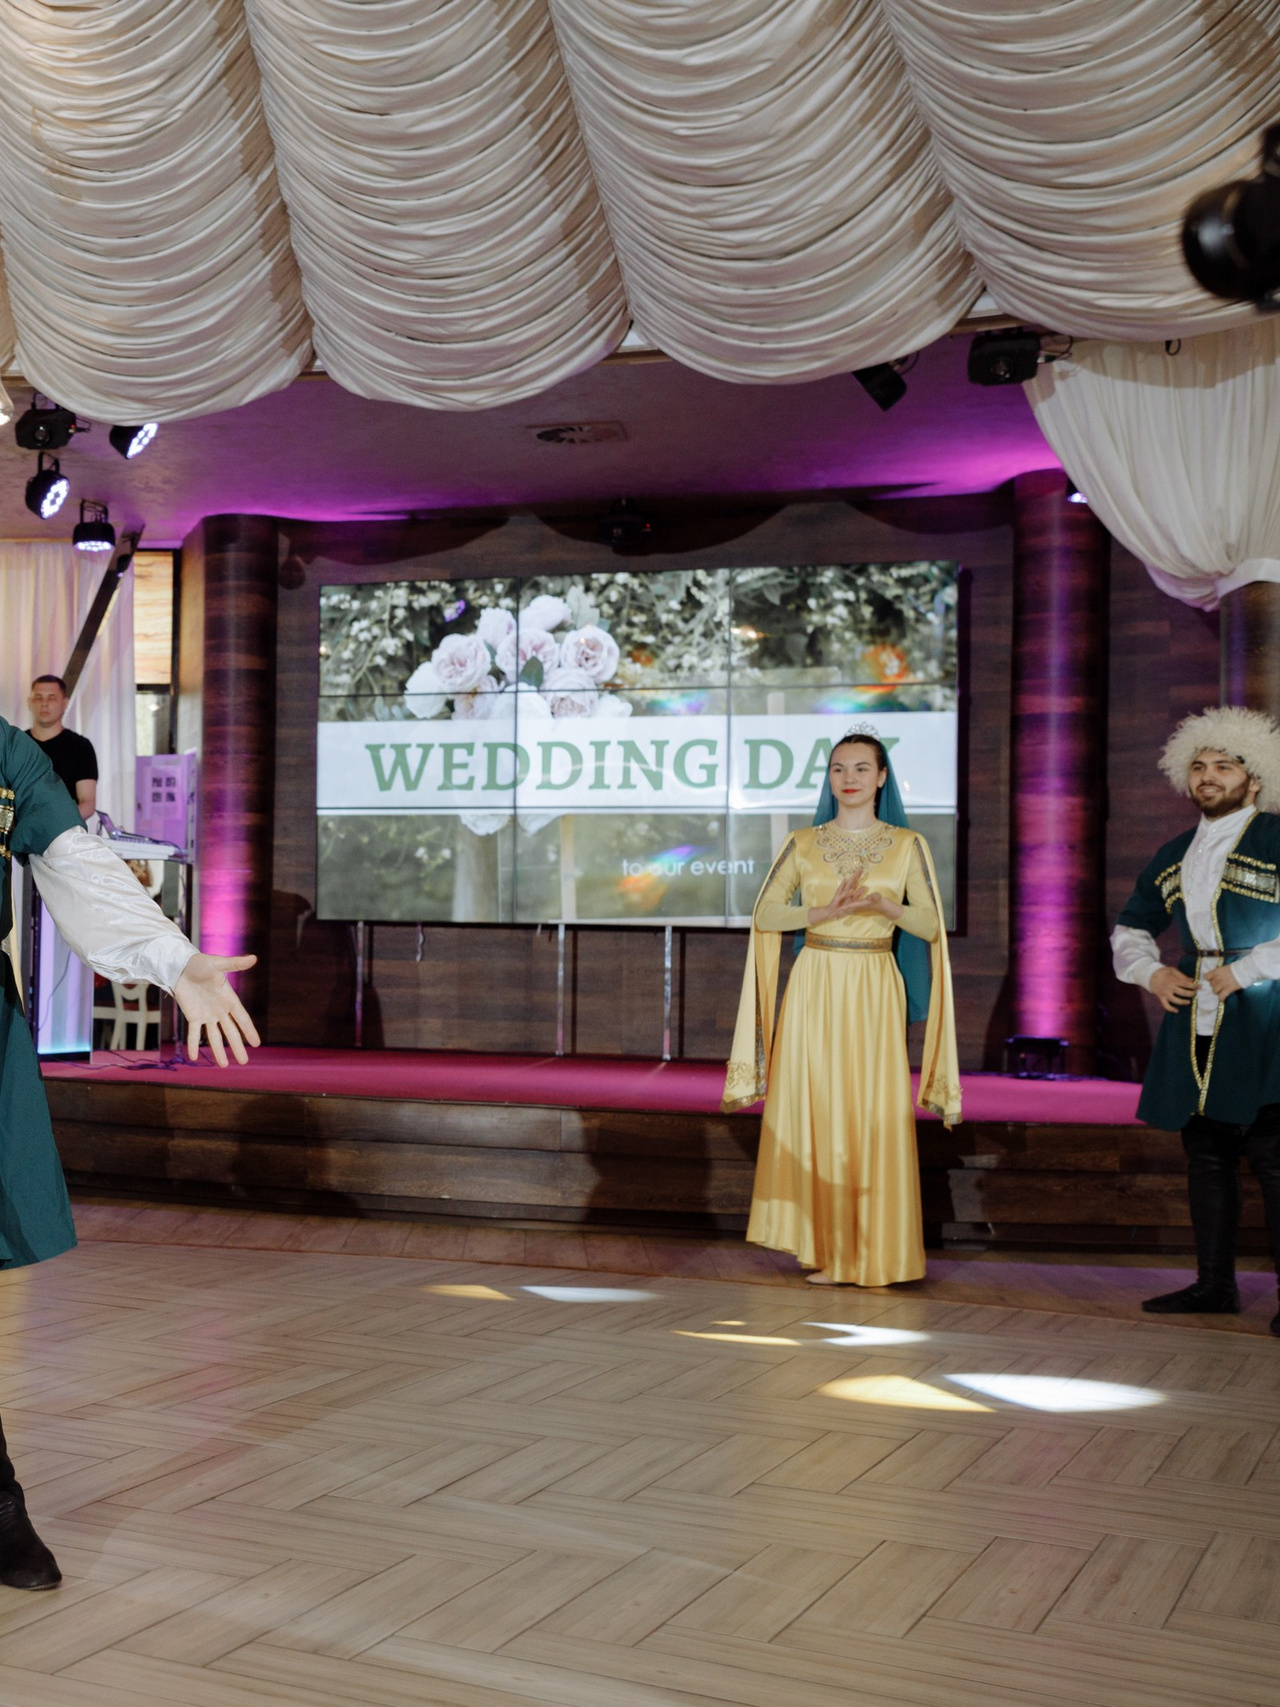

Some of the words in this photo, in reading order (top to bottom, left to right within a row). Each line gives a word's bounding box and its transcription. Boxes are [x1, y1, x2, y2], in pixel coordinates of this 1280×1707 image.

[365, 738, 719, 792] WEDDING
[743, 737, 900, 790] DA
[622, 859, 643, 876] to
[648, 859, 686, 876] our
[690, 857, 755, 876] event
